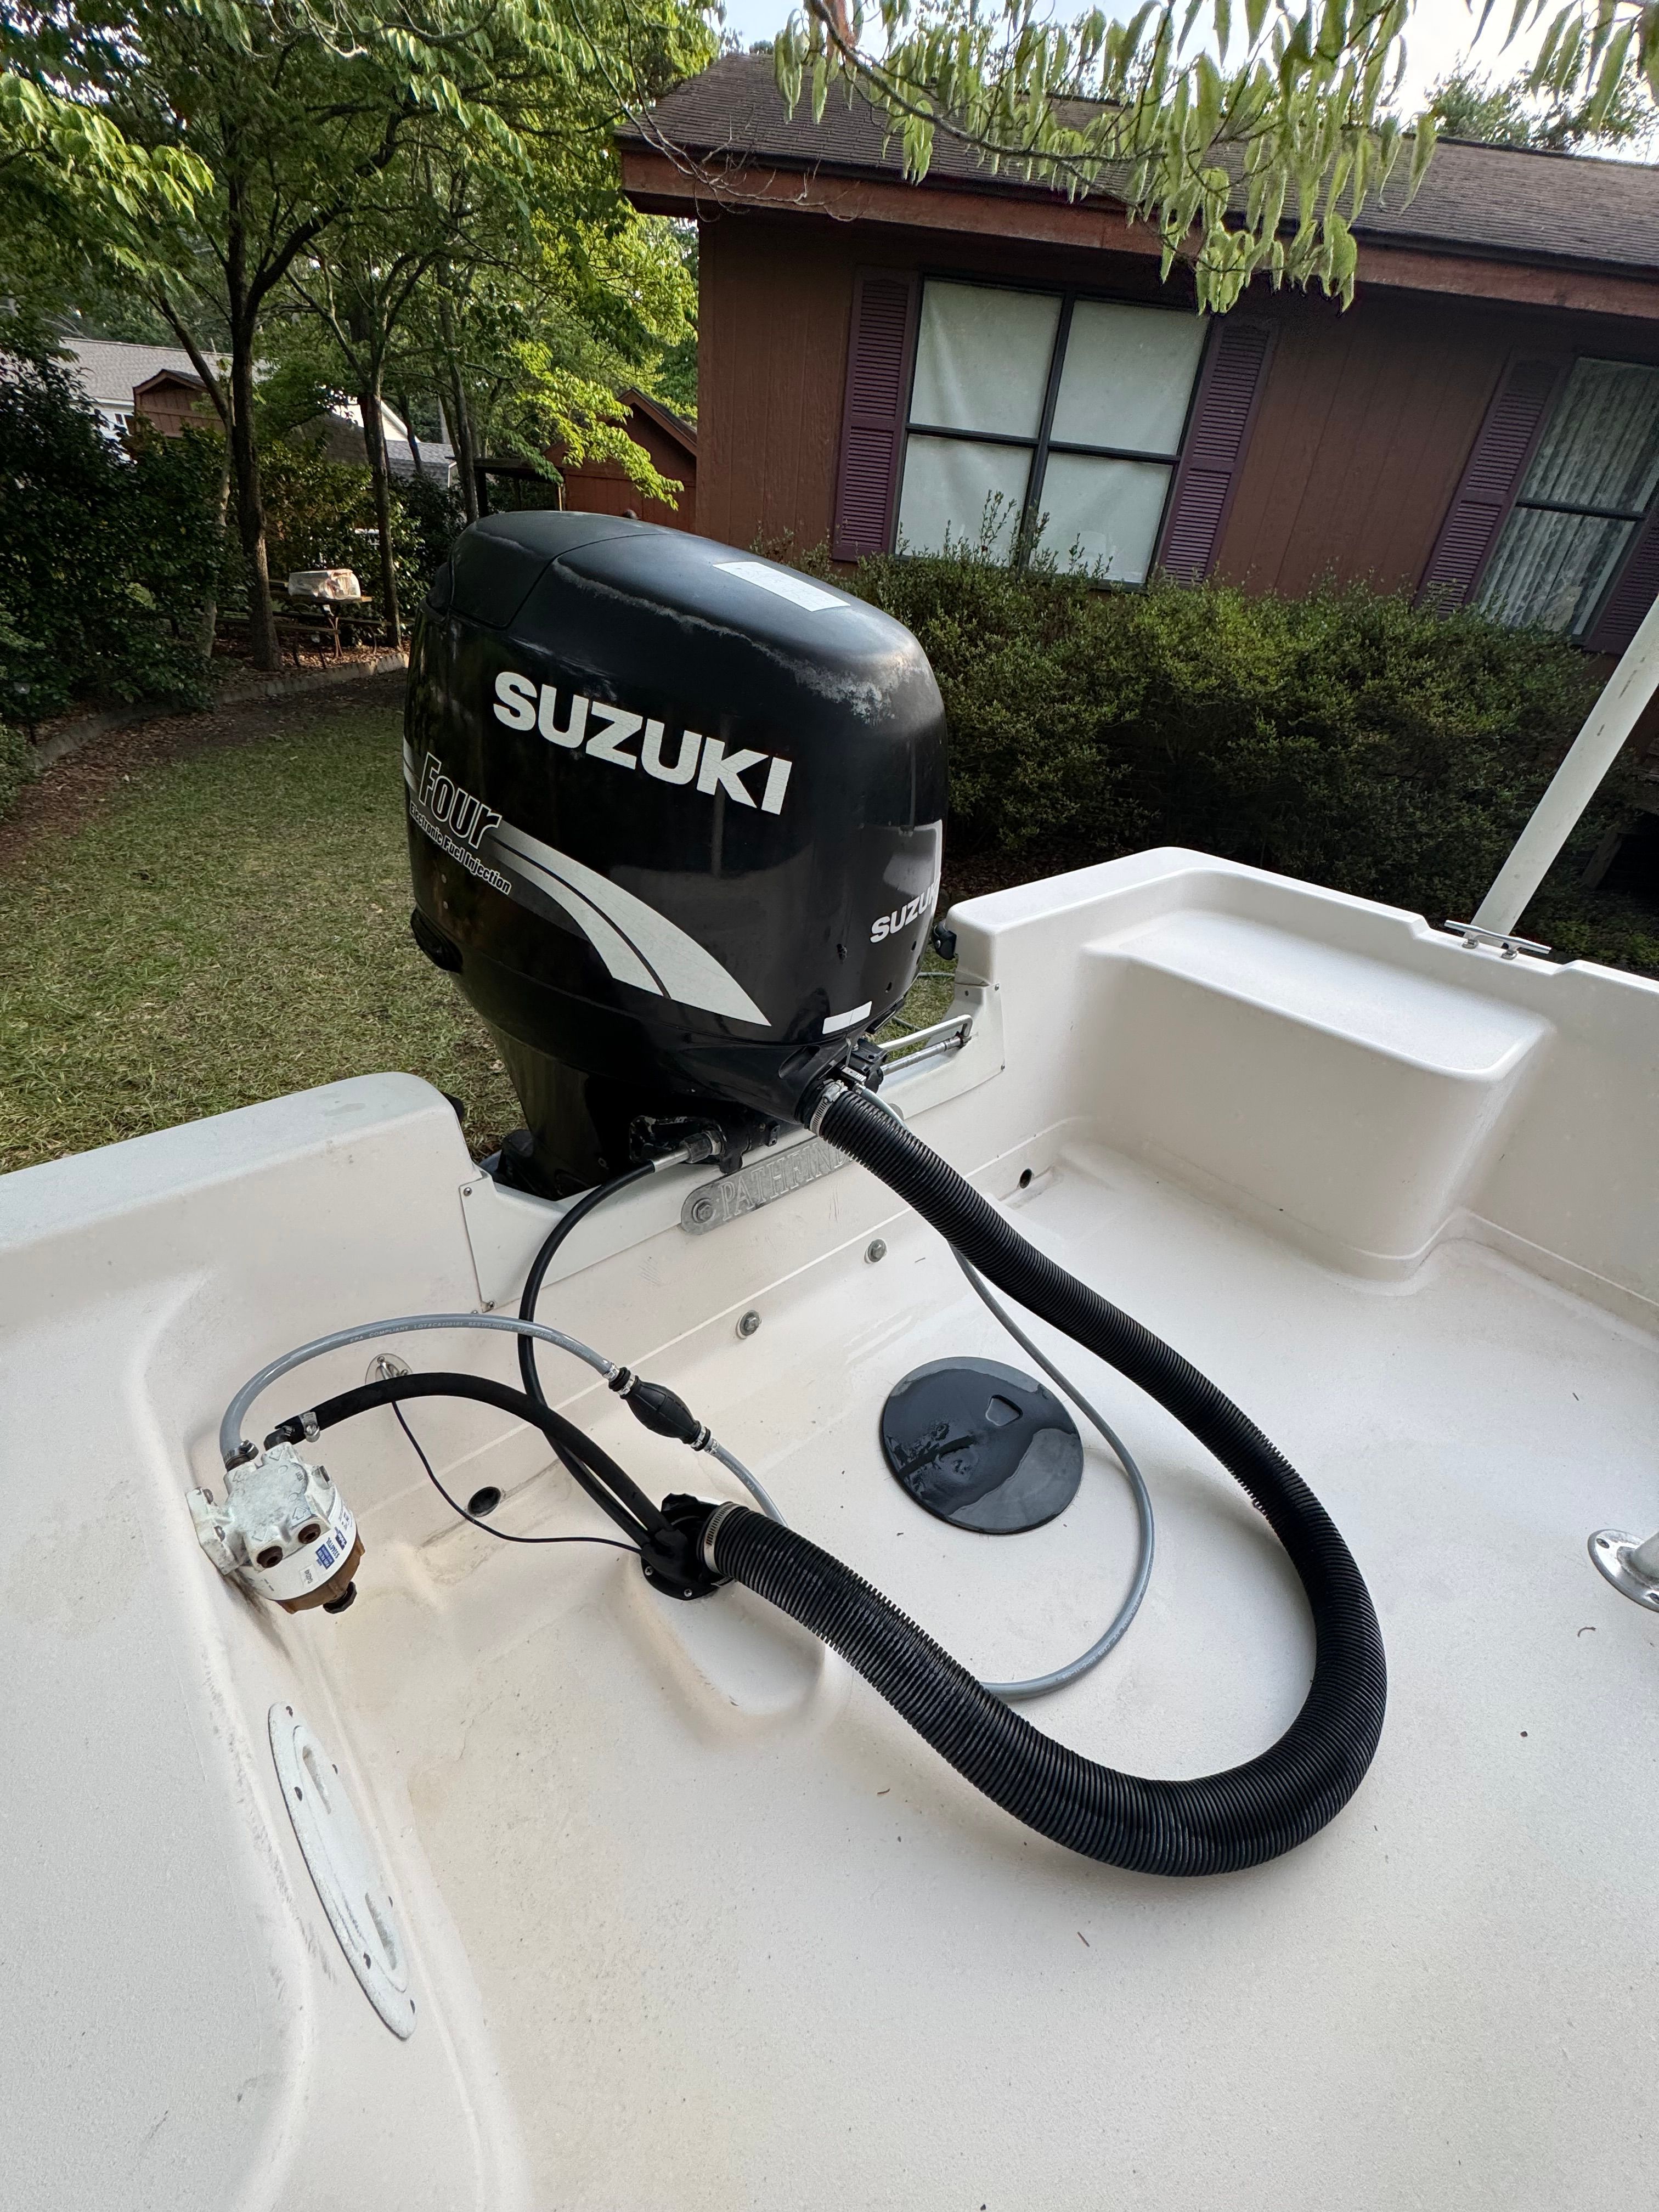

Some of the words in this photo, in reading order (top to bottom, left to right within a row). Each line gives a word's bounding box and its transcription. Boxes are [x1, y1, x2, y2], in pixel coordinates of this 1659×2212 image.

[493, 671, 793, 815] SUZUKI
[410, 800, 443, 846] Electronic
[442, 834, 465, 866] Fuel
[463, 852, 512, 895] Injection
[419, 751, 503, 849] Four
[870, 877, 940, 943] SUZUK
[349, 1335, 364, 1343] EPA
[369, 1325, 409, 1338] COMPLIANT
